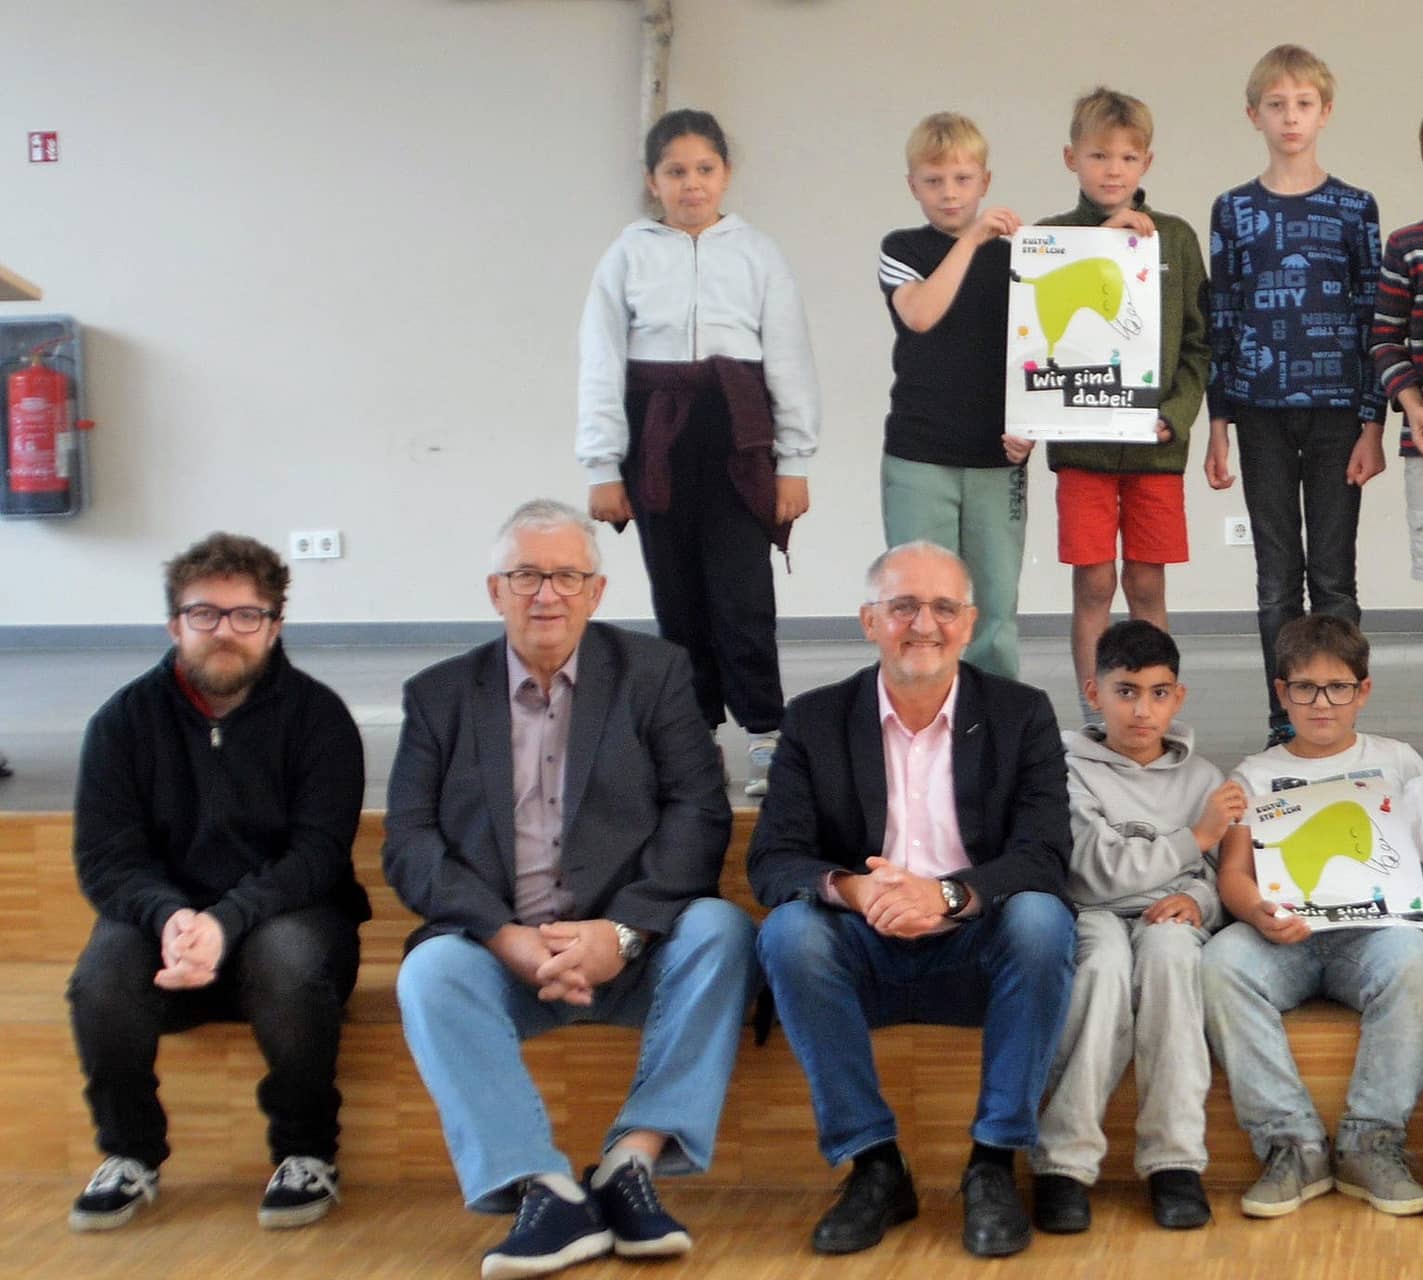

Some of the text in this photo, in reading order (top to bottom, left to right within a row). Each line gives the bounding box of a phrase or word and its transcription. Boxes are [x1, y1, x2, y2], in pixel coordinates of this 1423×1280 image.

[1255, 288, 1306, 309] CITY
[1033, 370, 1115, 388] Wir sind
[1072, 390, 1133, 407] dabei!
[1336, 902, 1380, 915] sind
